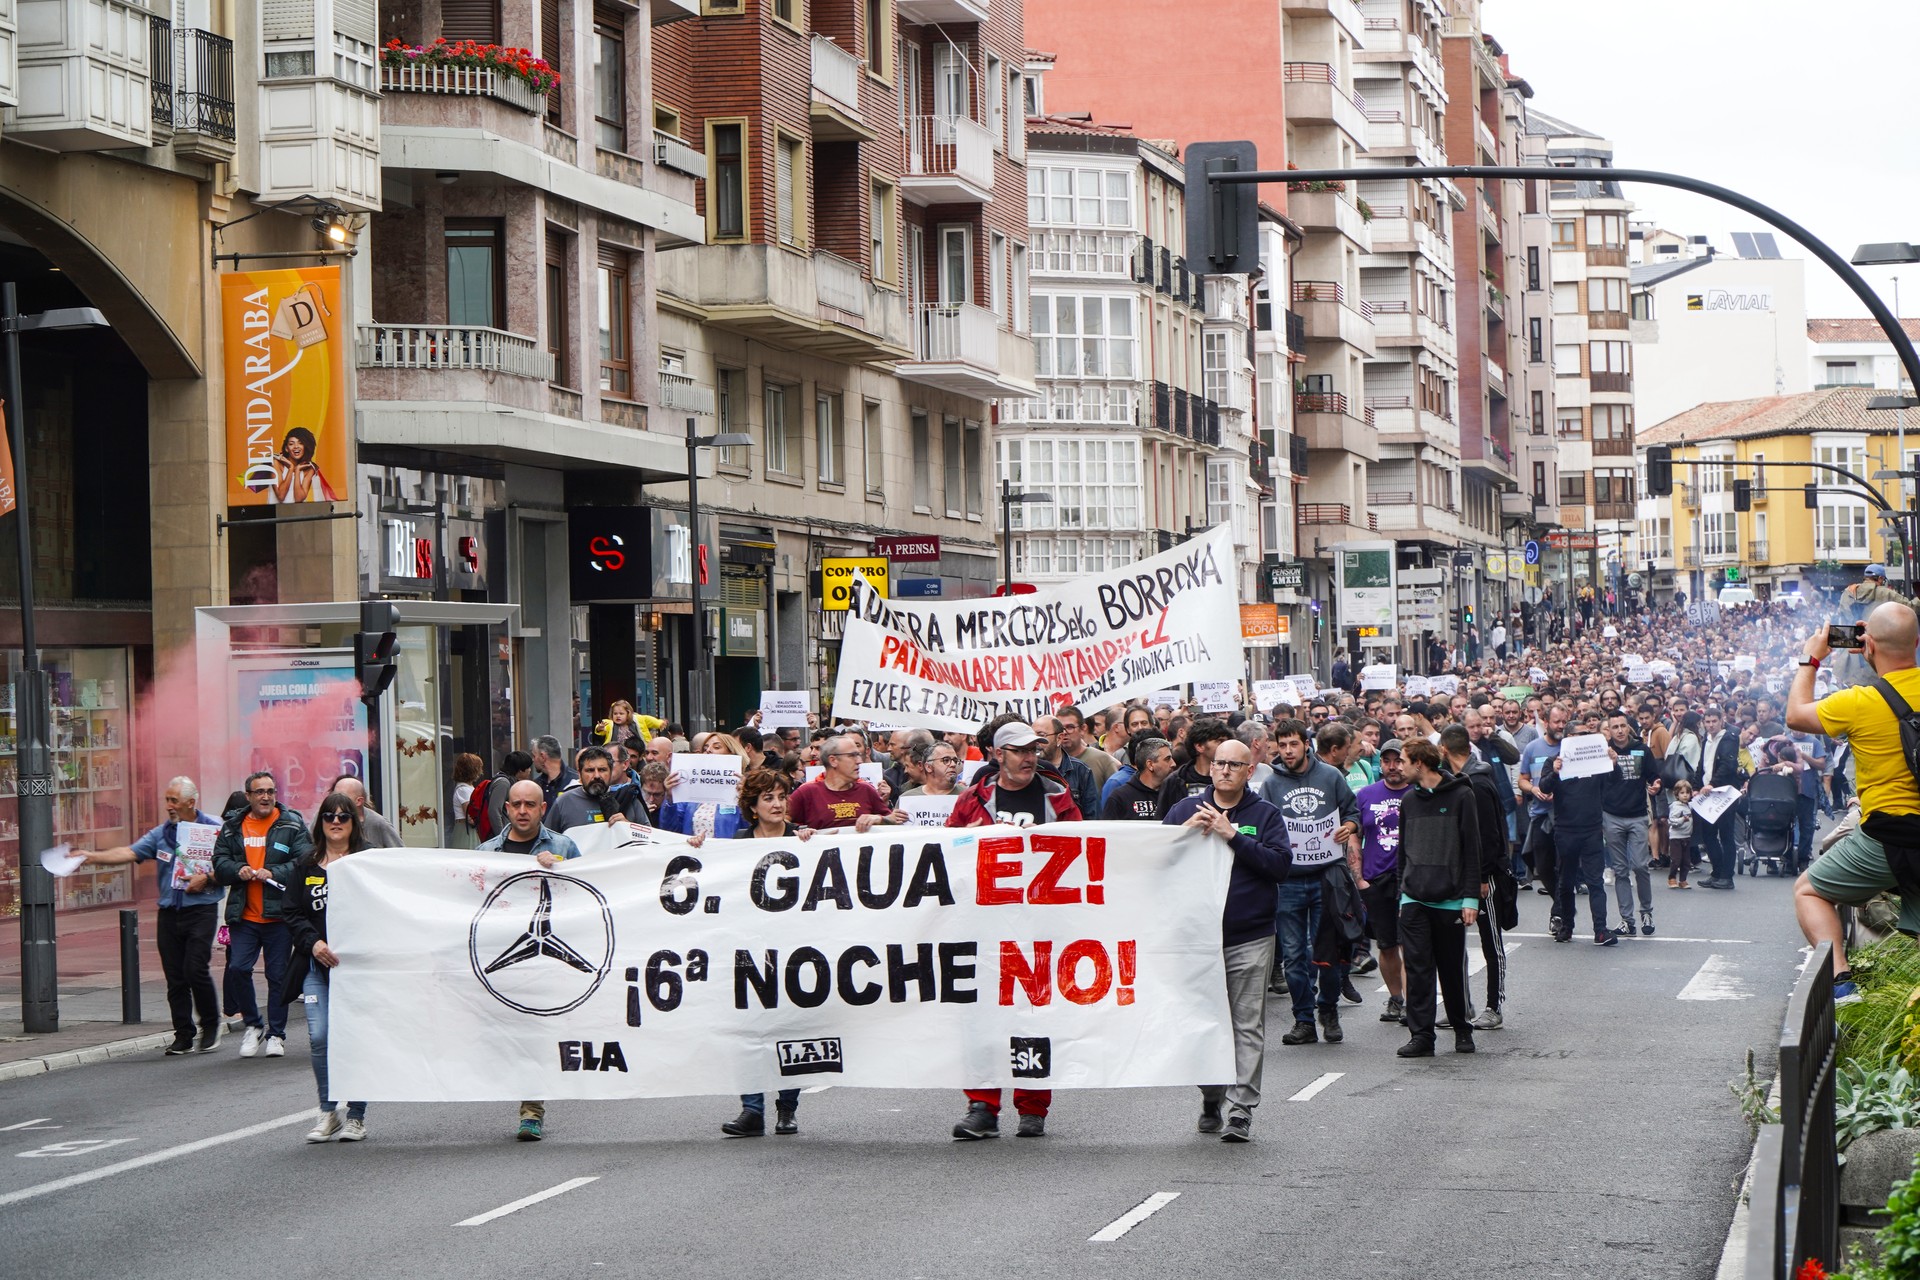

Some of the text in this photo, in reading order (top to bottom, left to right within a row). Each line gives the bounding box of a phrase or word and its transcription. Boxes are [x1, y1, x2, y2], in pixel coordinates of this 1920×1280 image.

[1707, 290, 1769, 310] PAVIAL
[289, 301, 314, 329] D
[243, 287, 279, 490] DENDARABA
[387, 519, 432, 579] Bliss
[879, 543, 936, 556] LA PRENSA
[1098, 543, 1222, 630] BORROKA
[1246, 625, 1276, 635] HORA
[1358, 627, 1379, 637] 8:56
[851, 679, 911, 712] EZKER
[1121, 633, 1211, 686] SINDIKATUA
[259, 683, 287, 696] JUEGA
[289, 683, 307, 695] CON
[1200, 682, 1230, 691] EMILIO TITOS
[692, 768, 699, 776] 6.
[700, 777, 724, 785] NOCHE
[1283, 787, 1325, 802] EDINBURGH
[916, 811, 930, 819] KPI
[1288, 817, 1334, 833] EMILIO TITOS
[1296, 850, 1332, 861] ETXERA
[660, 834, 1106, 916] 6. GAUA EZ!
[625, 939, 1137, 1028] ¡6ª NOCHE NO!
[559, 1041, 628, 1072] ELA
[782, 1040, 840, 1068] LAB
